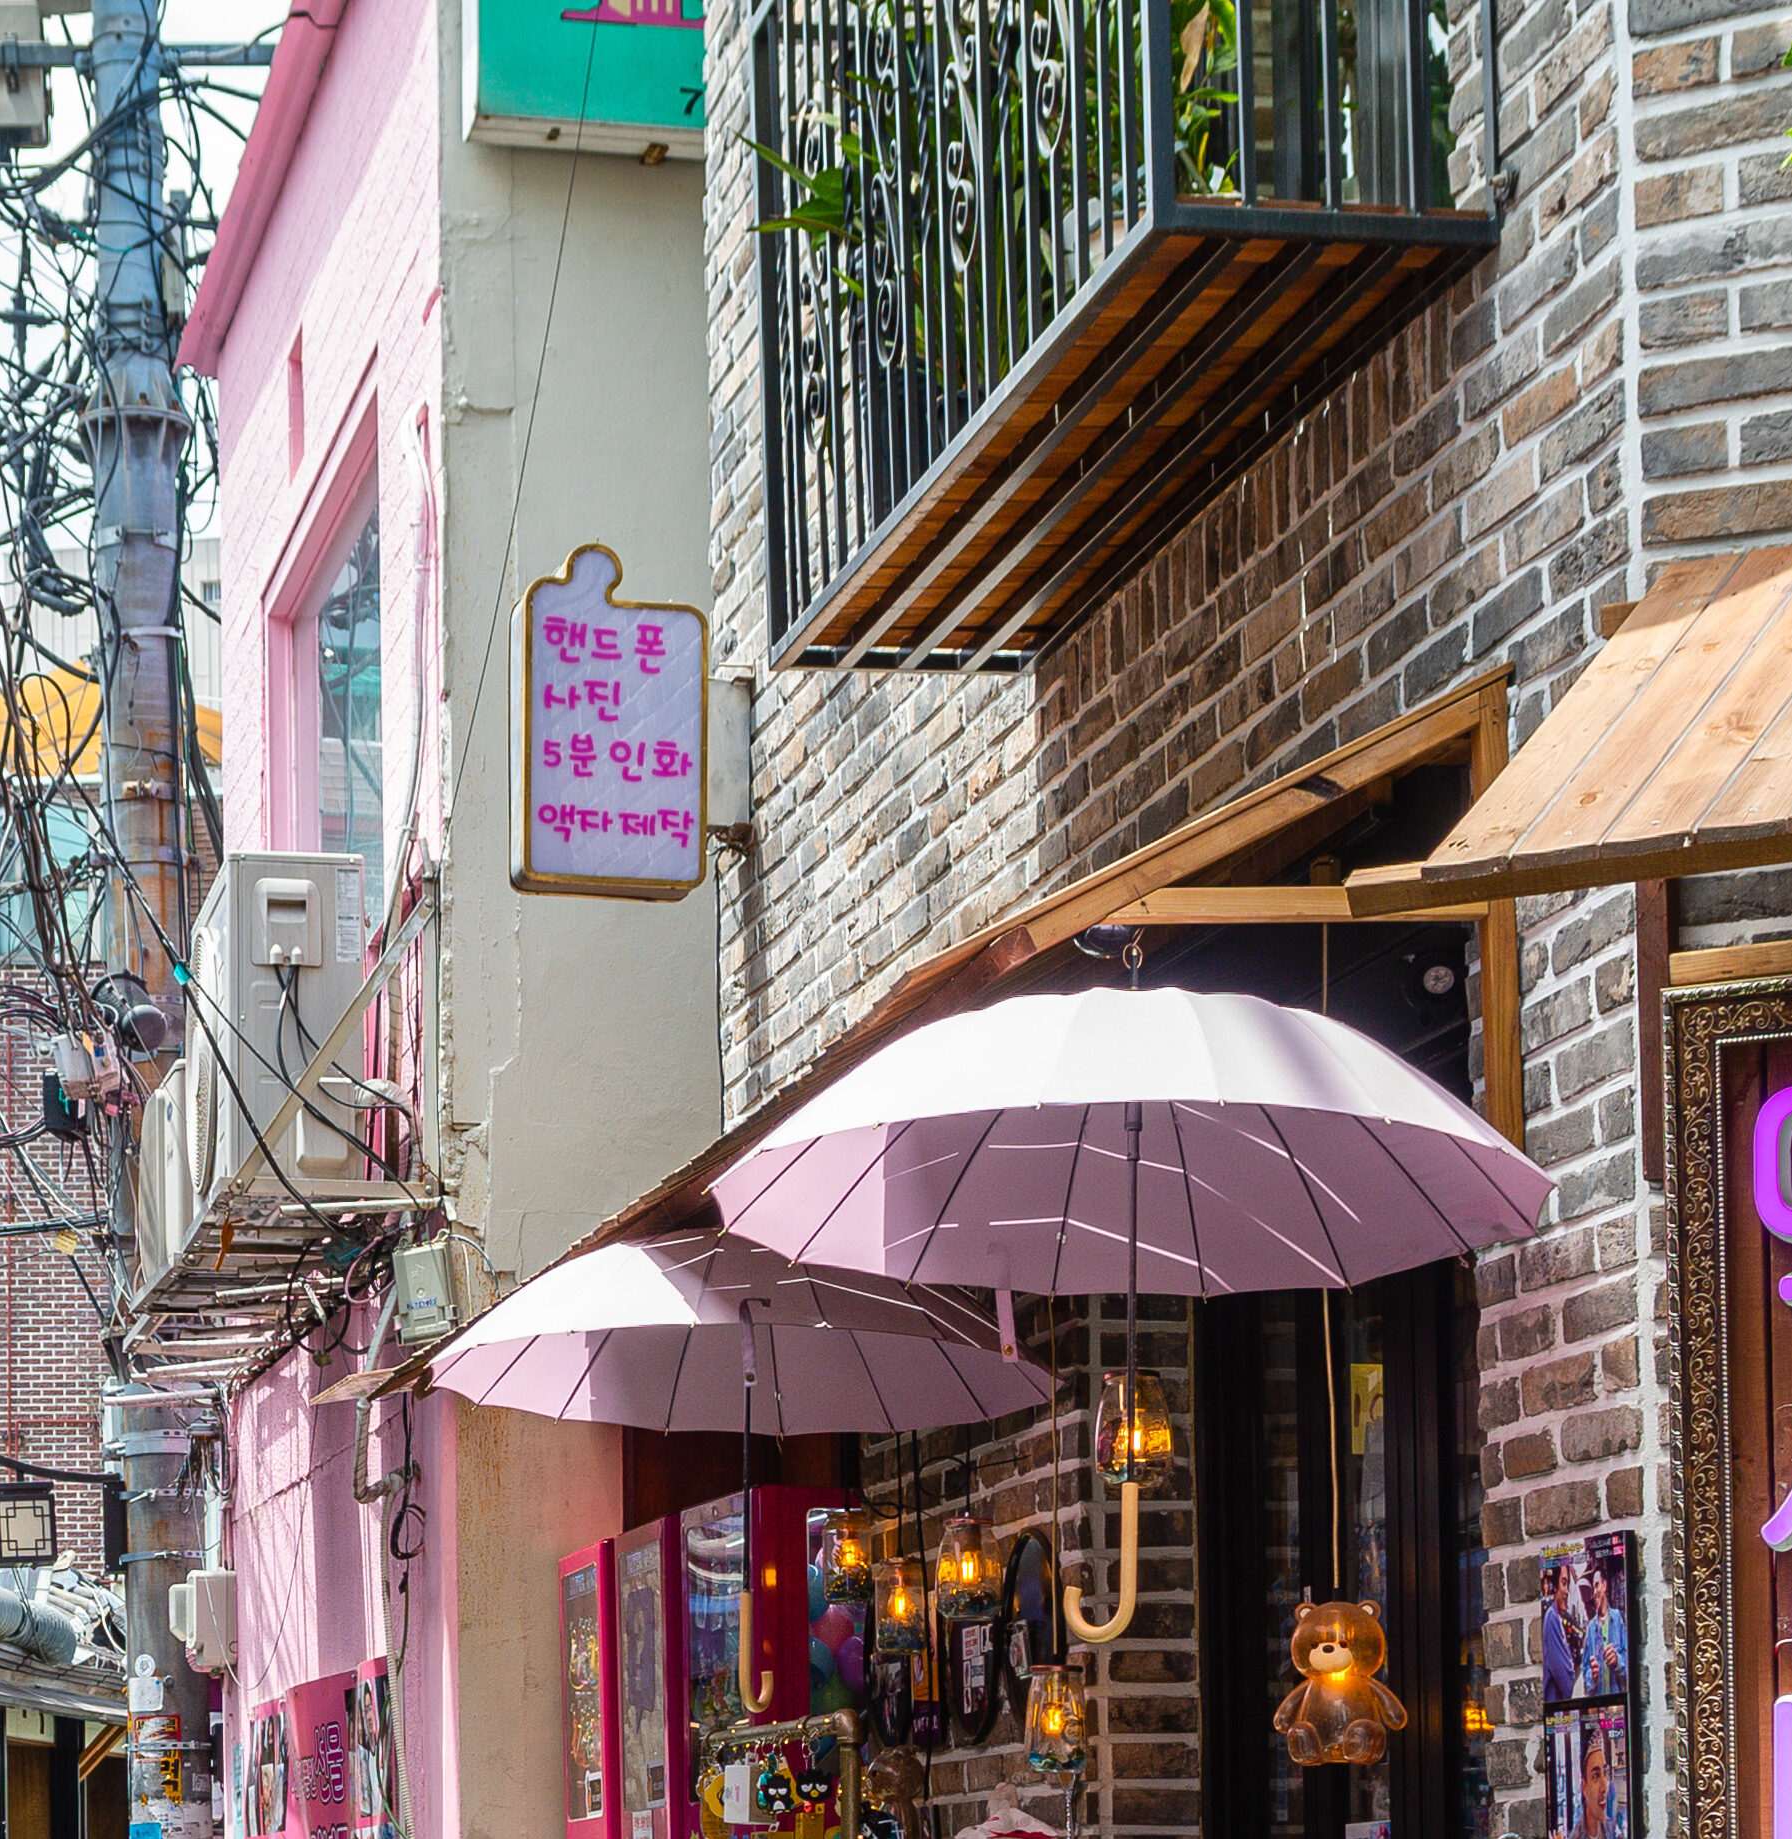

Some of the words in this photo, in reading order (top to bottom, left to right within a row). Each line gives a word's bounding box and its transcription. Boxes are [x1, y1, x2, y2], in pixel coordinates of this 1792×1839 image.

[543, 680, 621, 723] 사진
[543, 733, 597, 778] 5분
[609, 740, 693, 783] 인화
[538, 804, 613, 843] 액자
[618, 808, 695, 848] 제작
